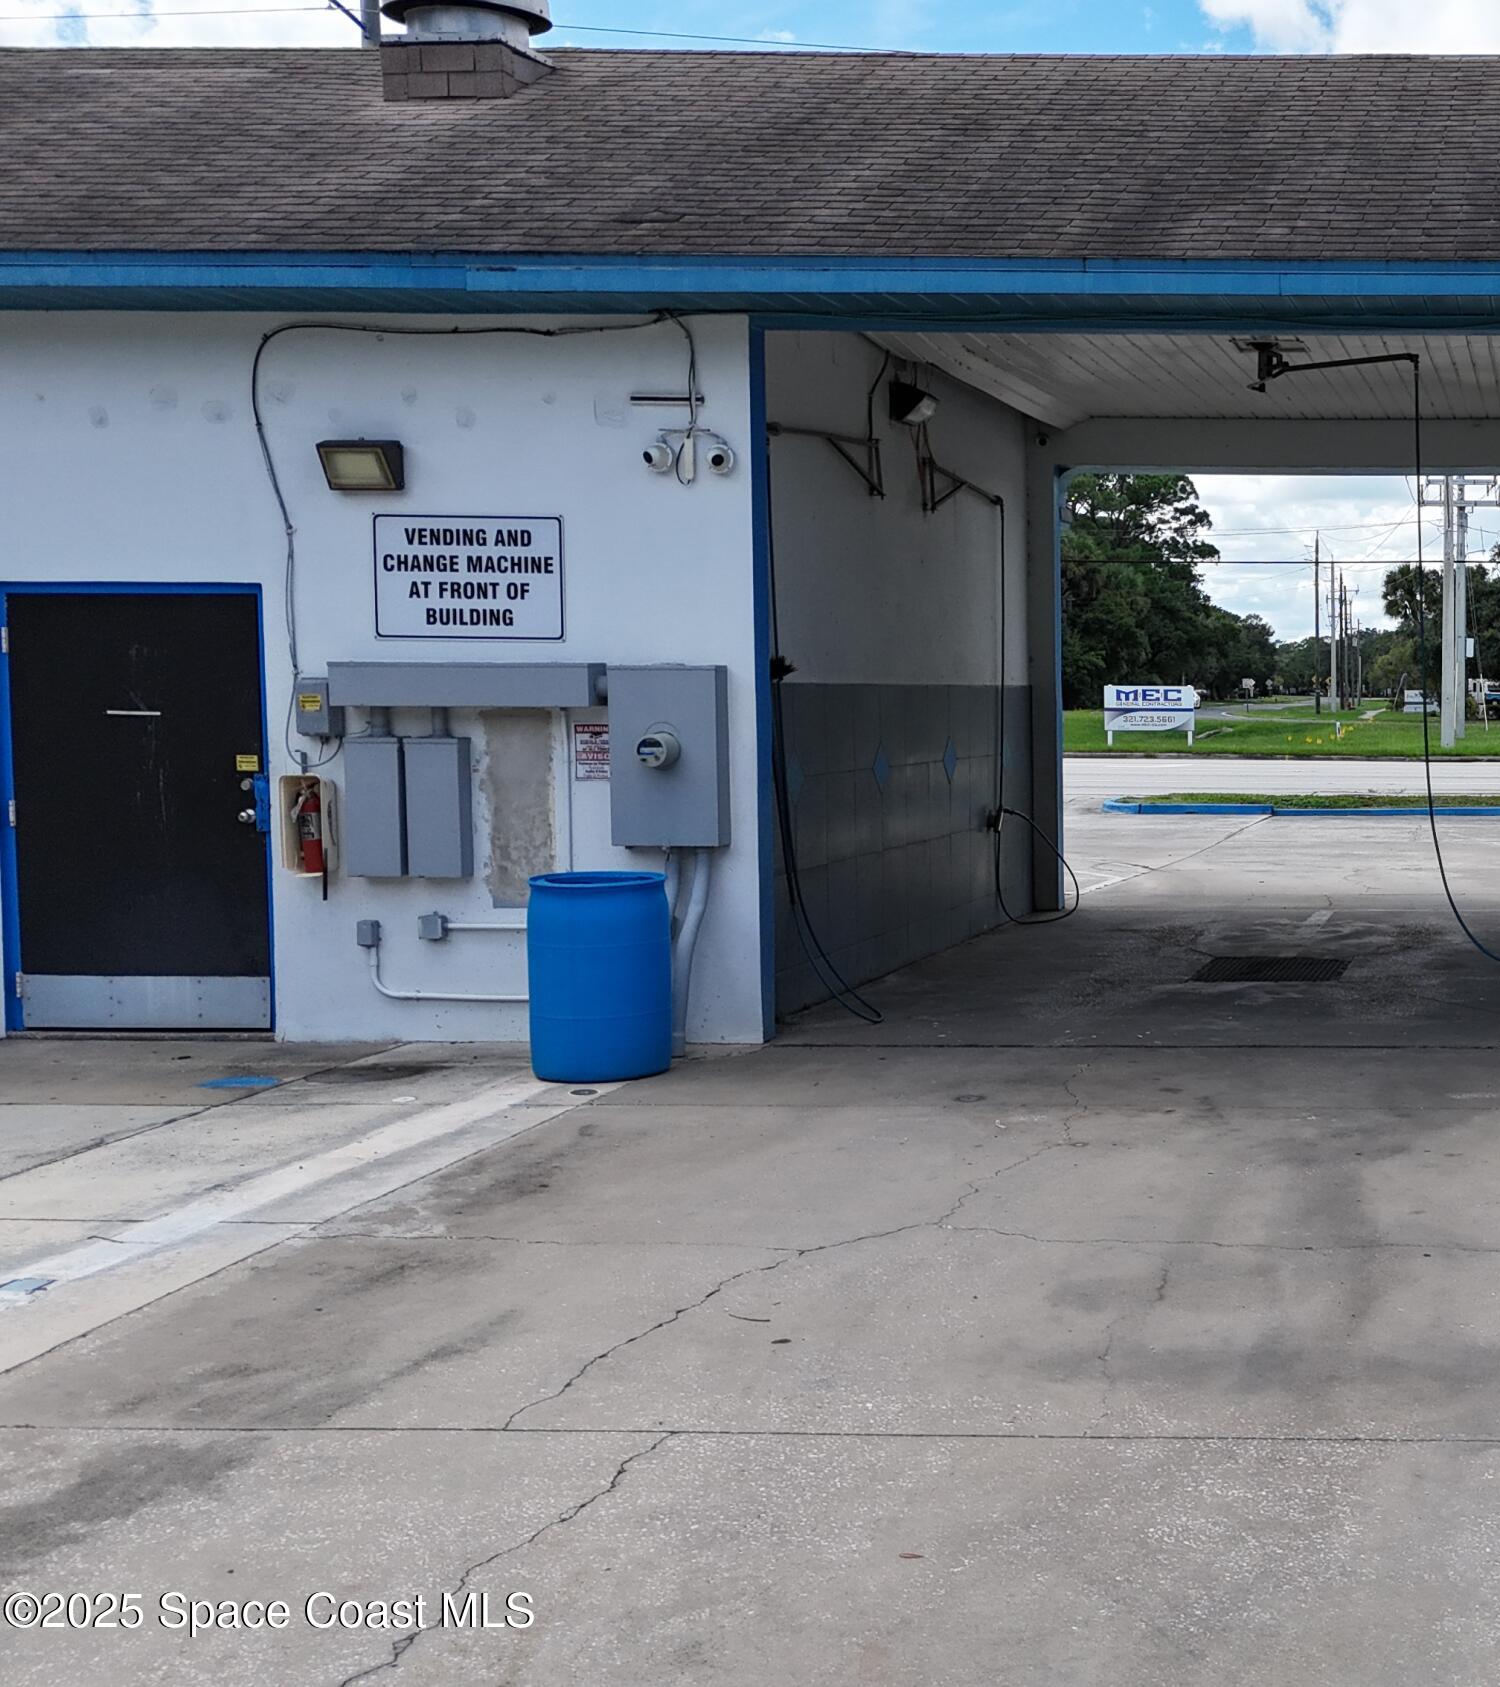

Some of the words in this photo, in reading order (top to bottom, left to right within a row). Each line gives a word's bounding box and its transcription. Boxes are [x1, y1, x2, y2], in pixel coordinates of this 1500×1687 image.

[404, 528, 487, 547] VENDING
[494, 529, 532, 547] AND
[382, 554, 460, 573] CHANGE
[466, 555, 554, 574] MACHINE
[408, 581, 432, 599] AT
[438, 582, 500, 600] FRONT
[506, 582, 530, 600] OF
[425, 608, 514, 627] BUILDING
[1122, 715, 1176, 723] 321.723.5661
